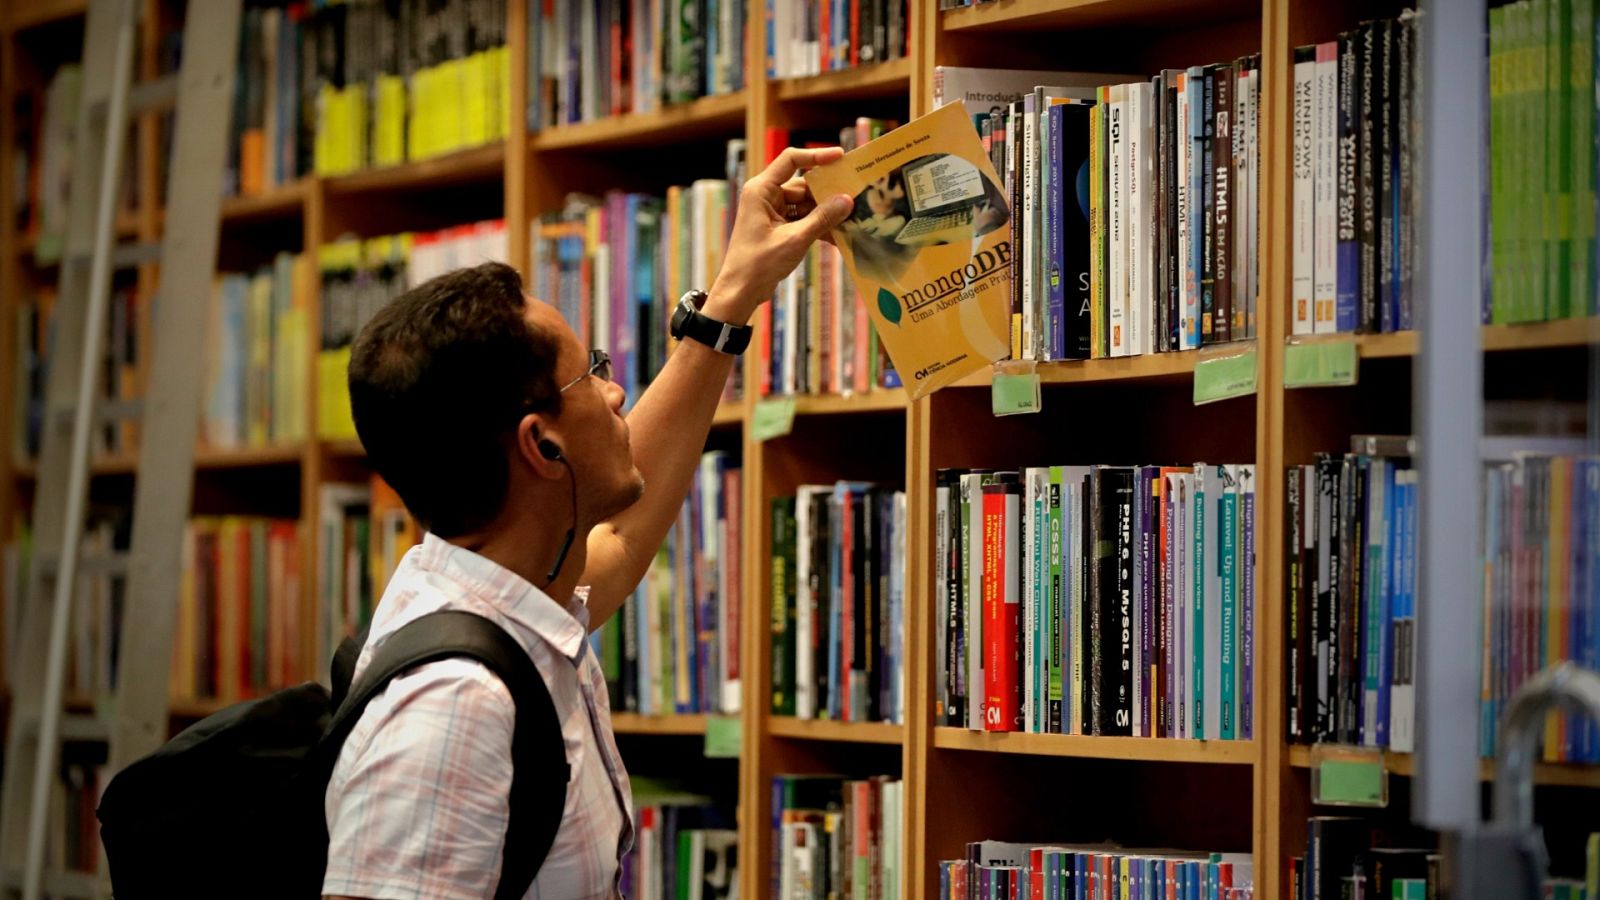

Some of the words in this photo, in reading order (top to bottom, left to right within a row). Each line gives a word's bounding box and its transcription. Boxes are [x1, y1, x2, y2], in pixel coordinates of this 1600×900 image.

[1364, 30, 1373, 114] Windows
[1383, 30, 1391, 98] Windows
[905, 140, 913, 151] de
[1112, 108, 1120, 154] SQL
[1303, 80, 1312, 179] WINDOWS
[1364, 120, 1373, 178] Server
[1383, 102, 1391, 149] Server
[1339, 137, 1347, 191] Server
[1347, 134, 1356, 239] Windows
[1216, 166, 1227, 225] HTML5
[1339, 197, 1347, 239] 2016
[1364, 186, 1373, 232] 2016
[1179, 230, 1185, 238] 5
[1217, 228, 1226, 245] EM
[902, 240, 1011, 309] mongoDB
[1216, 248, 1227, 280] AÇÃO
[910, 309, 935, 323] Uma
[936, 283, 989, 313] Abordagem
[1051, 518, 1059, 565] CSS3
[1122, 504, 1130, 544] PHP
[1165, 507, 1173, 580] Prototyping
[1122, 548, 1130, 559] 6
[1122, 568, 1129, 580] e
[1223, 554, 1232, 573] Up
[1120, 589, 1130, 654] MySQL
[1165, 603, 1173, 665] Designers
[1222, 607, 1232, 664] Running
[1122, 659, 1130, 671] 5
